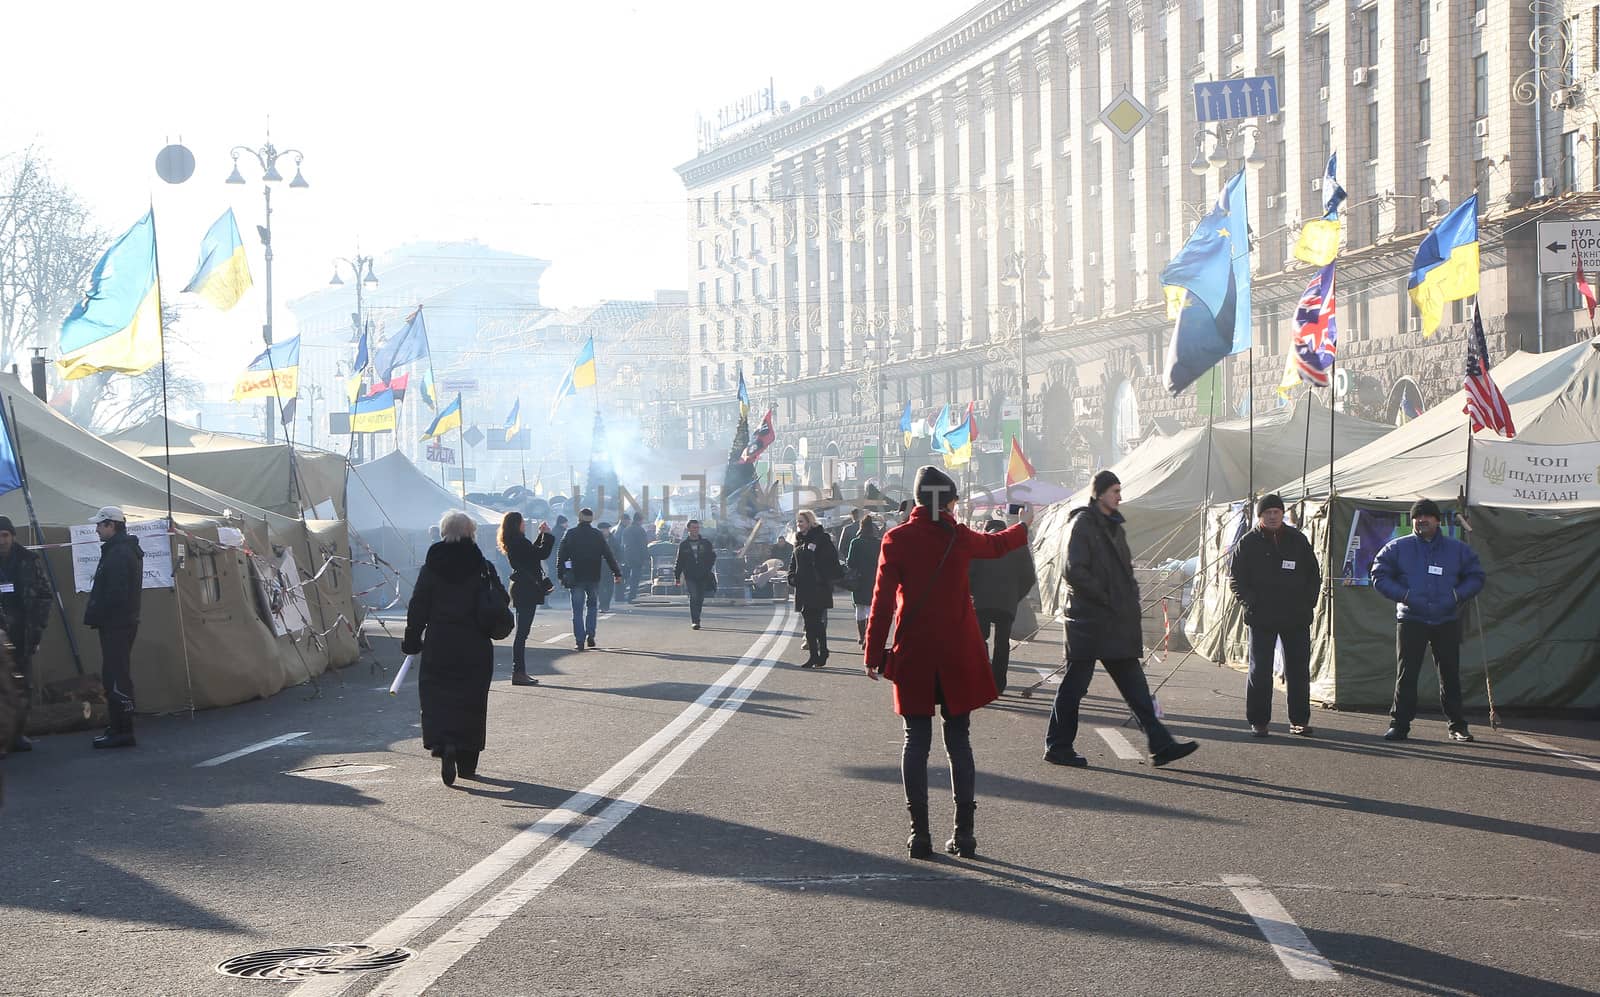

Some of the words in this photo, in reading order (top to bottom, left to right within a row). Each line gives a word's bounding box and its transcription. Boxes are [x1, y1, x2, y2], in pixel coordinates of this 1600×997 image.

[1527, 456, 1568, 467] ЧОП
[1508, 470, 1592, 483] ПІДТРИМУЄ
[1513, 489, 1578, 502] МАЙДАН
